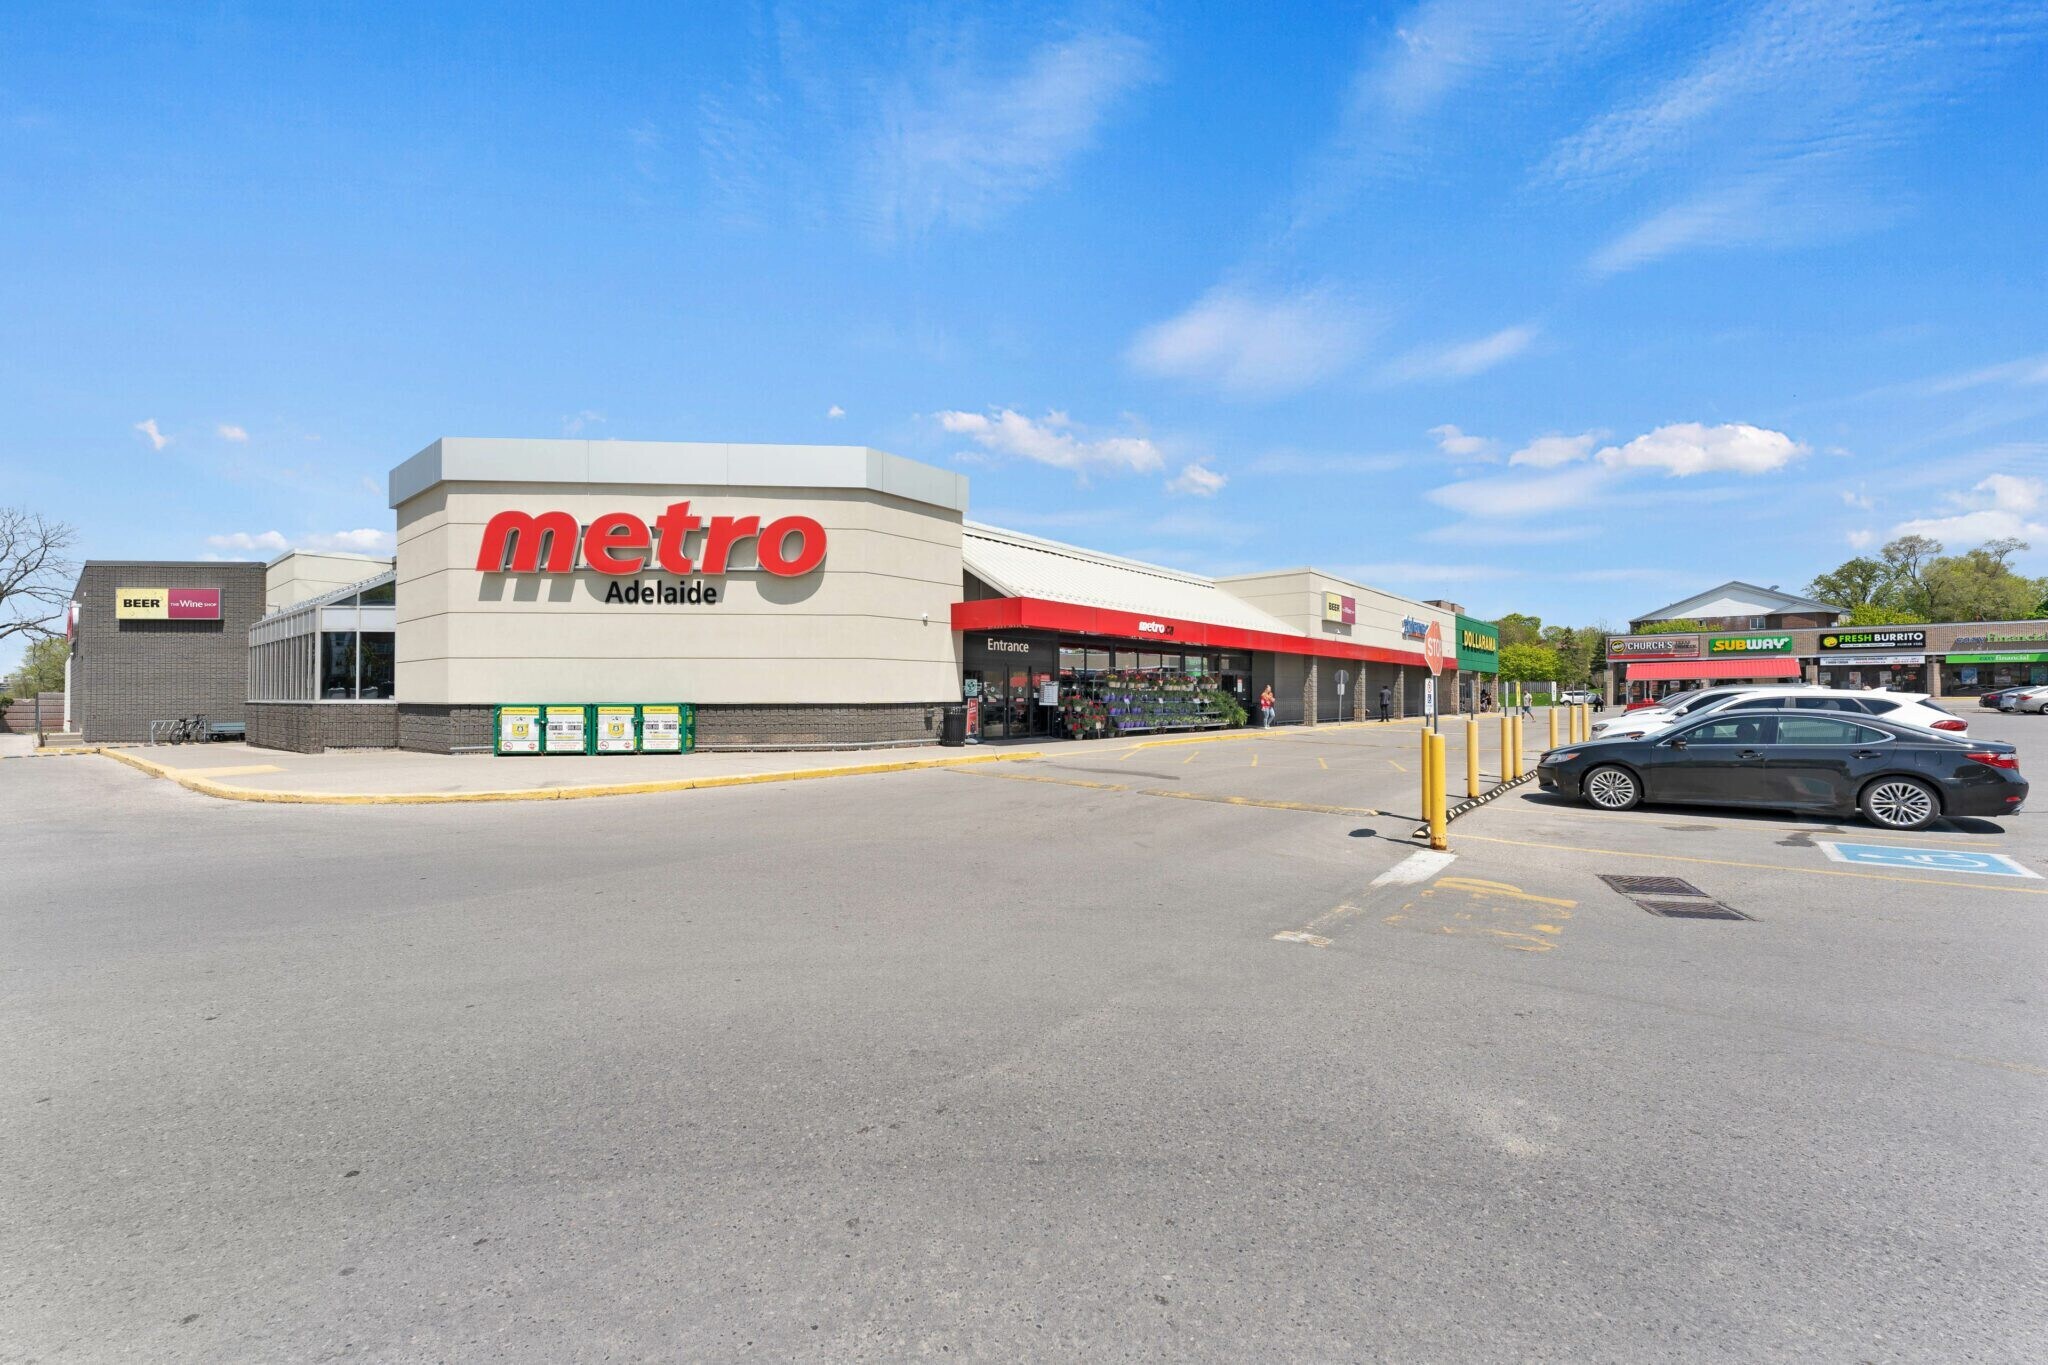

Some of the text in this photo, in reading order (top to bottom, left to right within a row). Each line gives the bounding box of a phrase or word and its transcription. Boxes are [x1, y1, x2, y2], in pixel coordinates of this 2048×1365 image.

[476, 500, 827, 578] metro
[605, 580, 718, 604] Adelaide
[123, 599, 160, 608] BEER
[179, 600, 203, 608] Wine
[1328, 602, 1340, 612] BEER
[1138, 621, 1174, 636] metro.ca
[1463, 630, 1496, 651] DOLLARAMA
[1713, 637, 1790, 651] SUBWAY
[1838, 632, 1924, 643] FRESH BURRITO
[987, 638, 1030, 653] Entrance
[1428, 637, 1442, 657] STO
[1627, 641, 1673, 650] CHURCH'S
